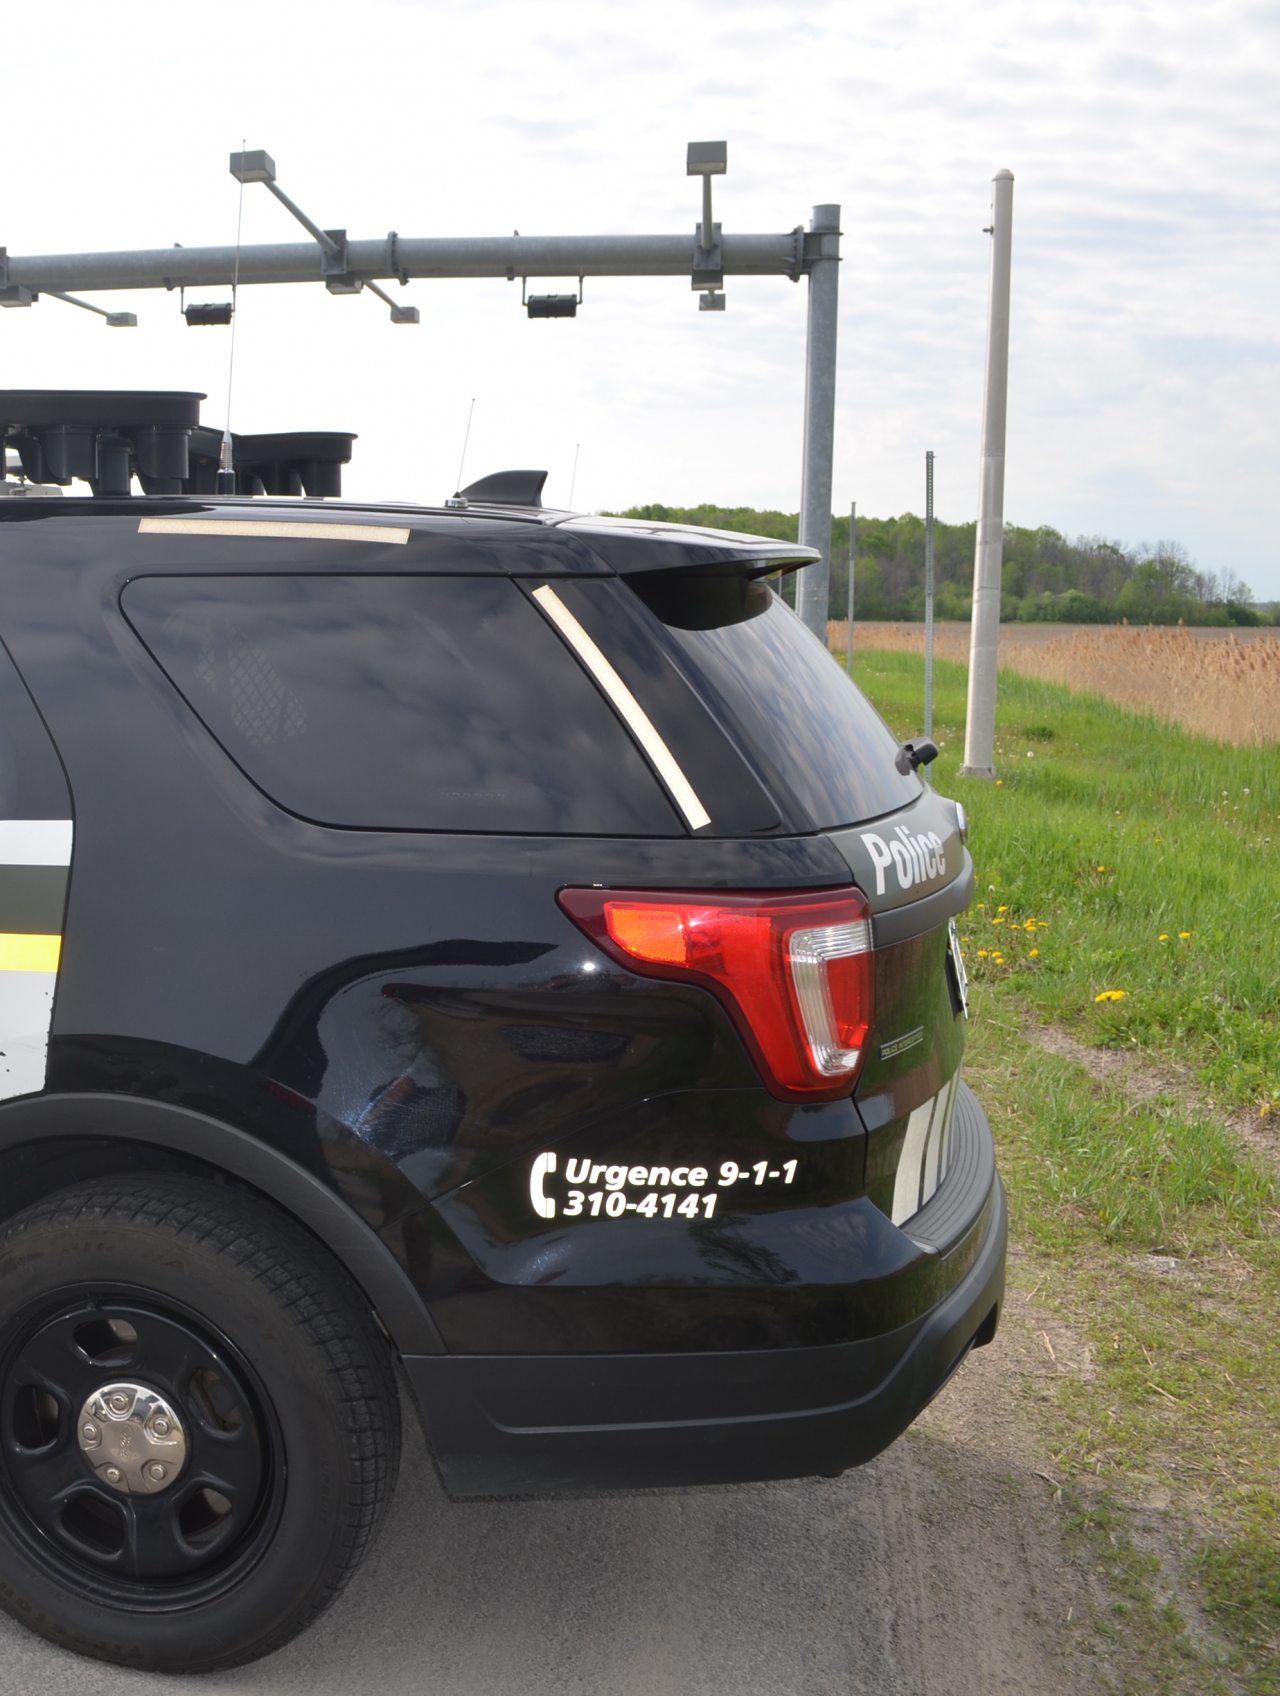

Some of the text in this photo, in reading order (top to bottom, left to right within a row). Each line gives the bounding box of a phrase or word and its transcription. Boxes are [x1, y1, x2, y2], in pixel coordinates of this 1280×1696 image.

[860, 825, 946, 896] Police
[565, 1158, 798, 1191] Urgence 9-1-1
[563, 1190, 718, 1219] 310-4141
